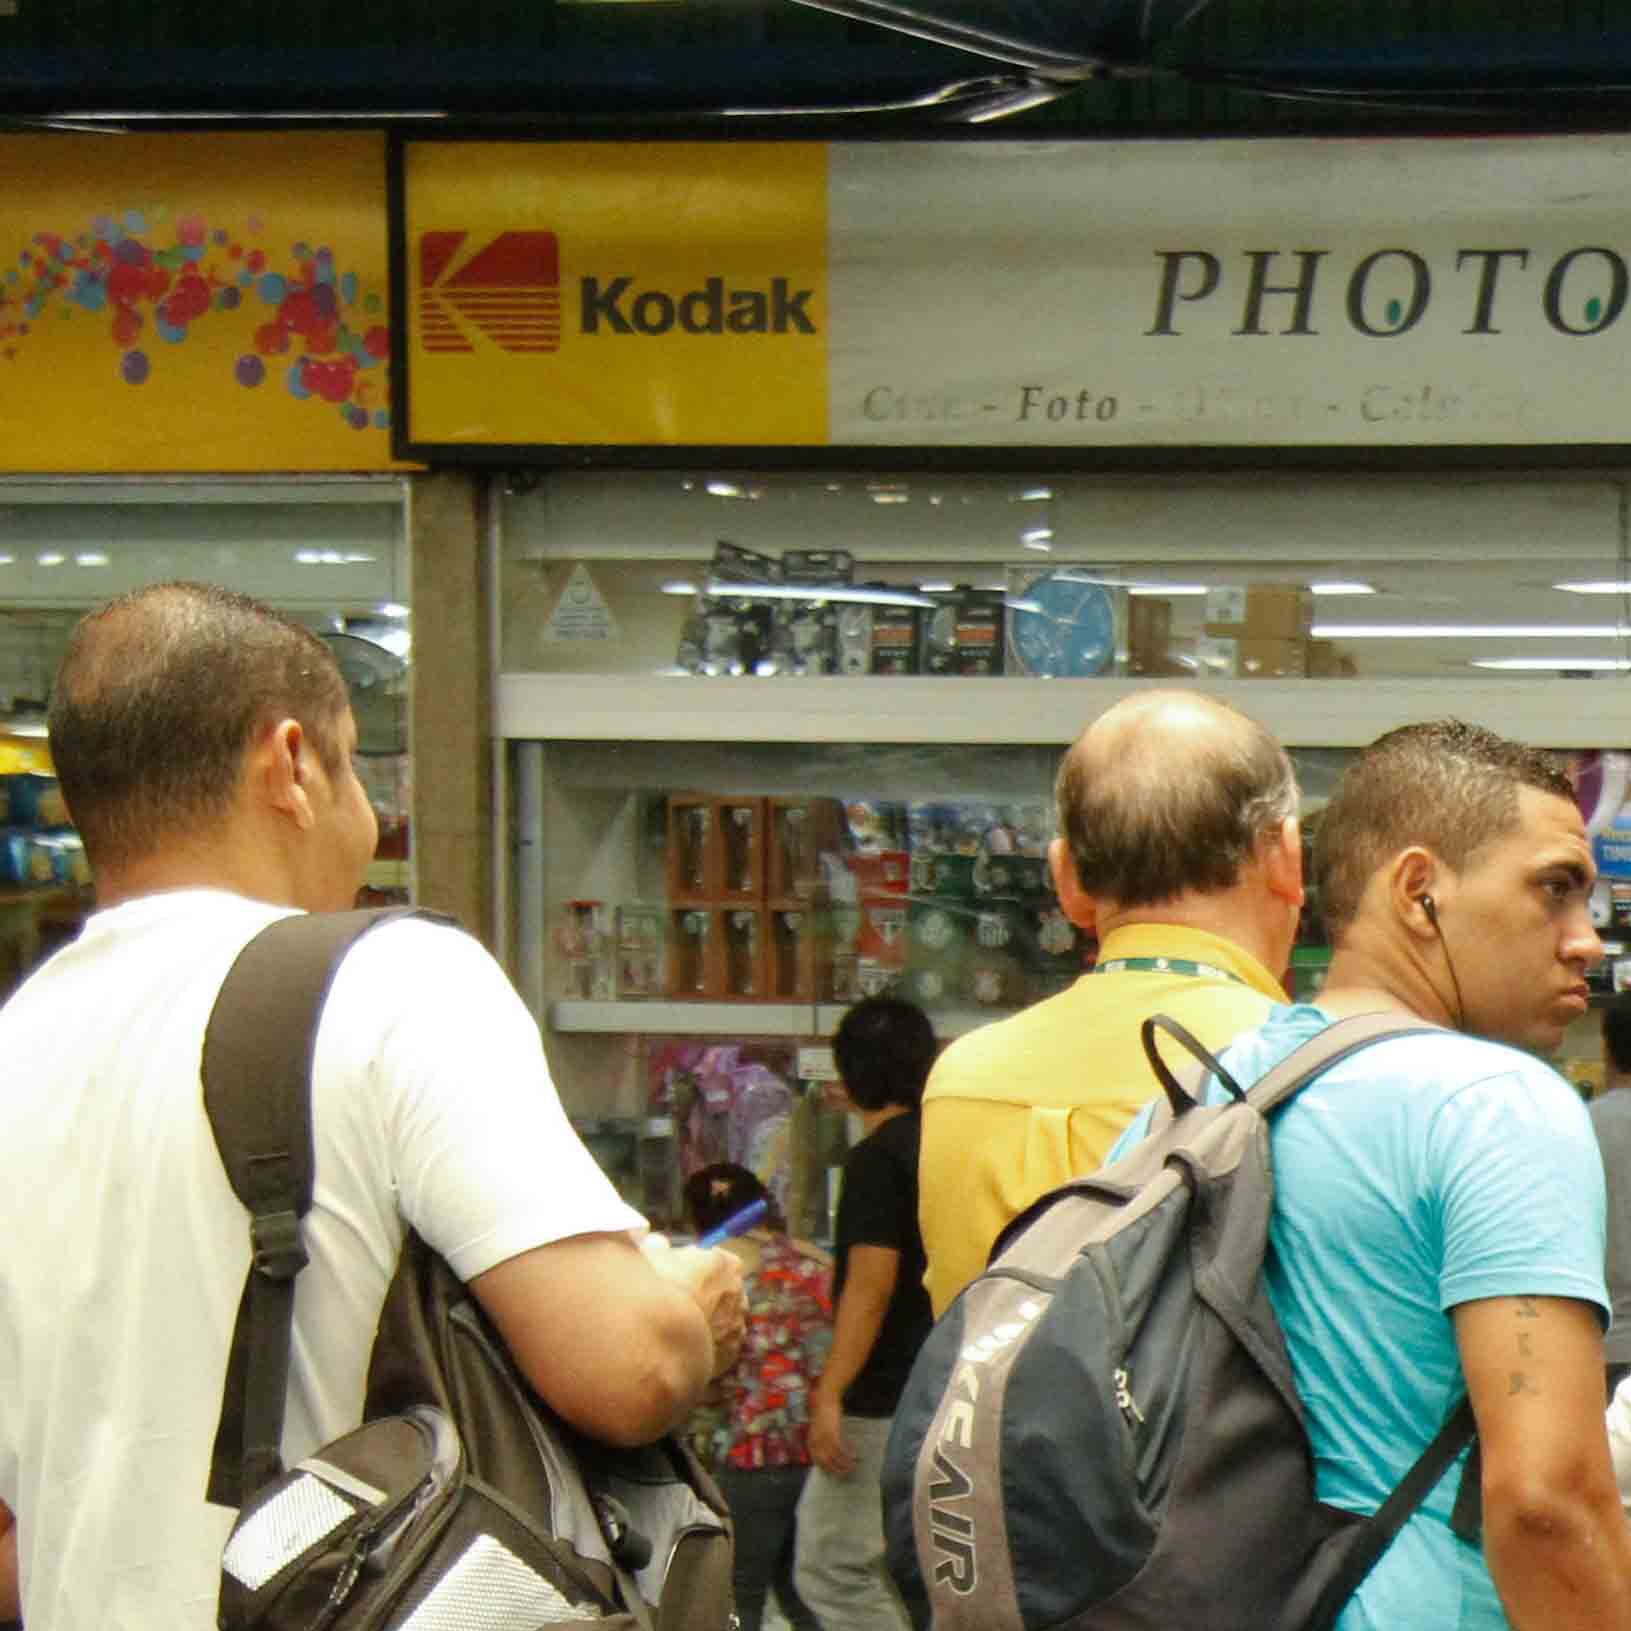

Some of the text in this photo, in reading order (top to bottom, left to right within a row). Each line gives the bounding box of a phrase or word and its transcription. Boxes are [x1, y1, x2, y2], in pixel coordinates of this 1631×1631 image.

[580, 276, 817, 337] Kodak
[1016, 386, 1119, 422] Foto
[927, 1440, 978, 1597] AIR
